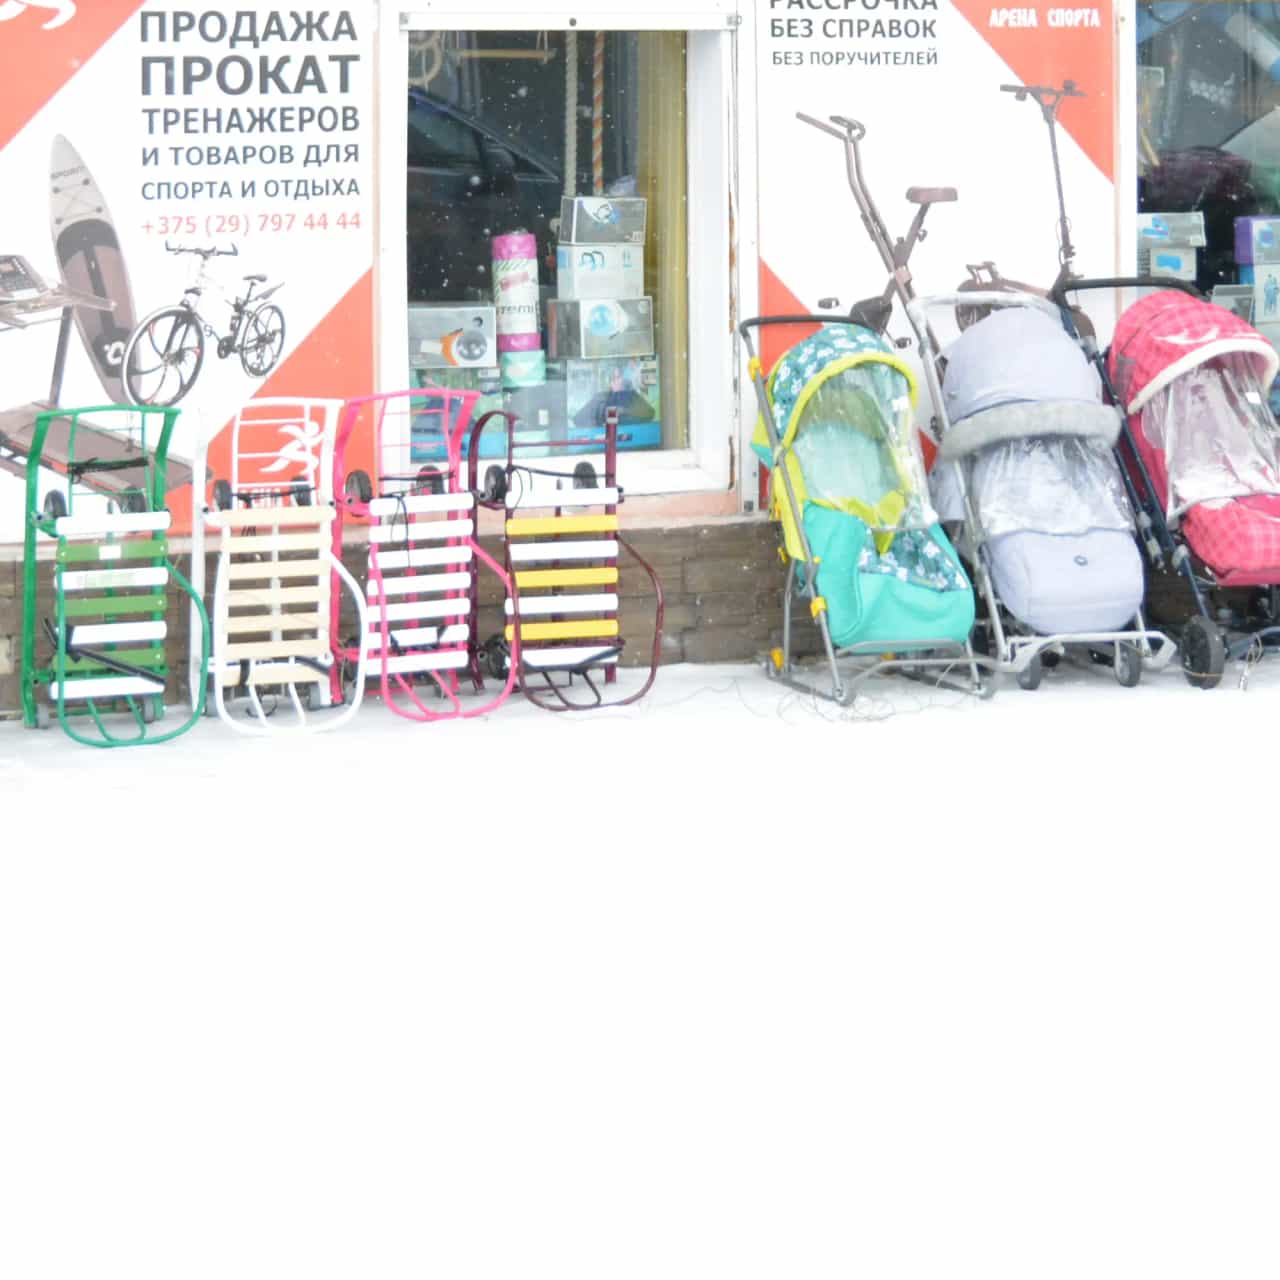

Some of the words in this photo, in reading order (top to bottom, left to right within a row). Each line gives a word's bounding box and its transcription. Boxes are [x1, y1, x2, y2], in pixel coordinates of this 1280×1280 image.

[139, 10, 358, 49] ПРОДАЖА
[770, 18, 814, 38] БЕЗ
[822, 18, 937, 39] СПРАВОК
[988, 7, 1039, 28] АРЕНА
[1046, 7, 1101, 28] СПОРТА
[772, 50, 804, 66] БЕЗ
[809, 47, 938, 66] ПОРУЧИТЕЛЕЙ
[141, 54, 361, 96] ПРОКАТ
[141, 105, 360, 135] ТРЕНАЖЕРОВ
[141, 147, 159, 167] И
[168, 144, 295, 166] ТОВАРОВ
[303, 143, 359, 168] ДЛЯ
[141, 180, 233, 201] СПОРТА
[241, 180, 256, 199] И
[263, 178, 360, 201] ОТДЫХА
[141, 215, 197, 235] +375
[204, 214, 250, 237] (29)
[257, 212, 297, 232] 797
[303, 212, 329, 231] 44
[335, 211, 361, 230] 44
